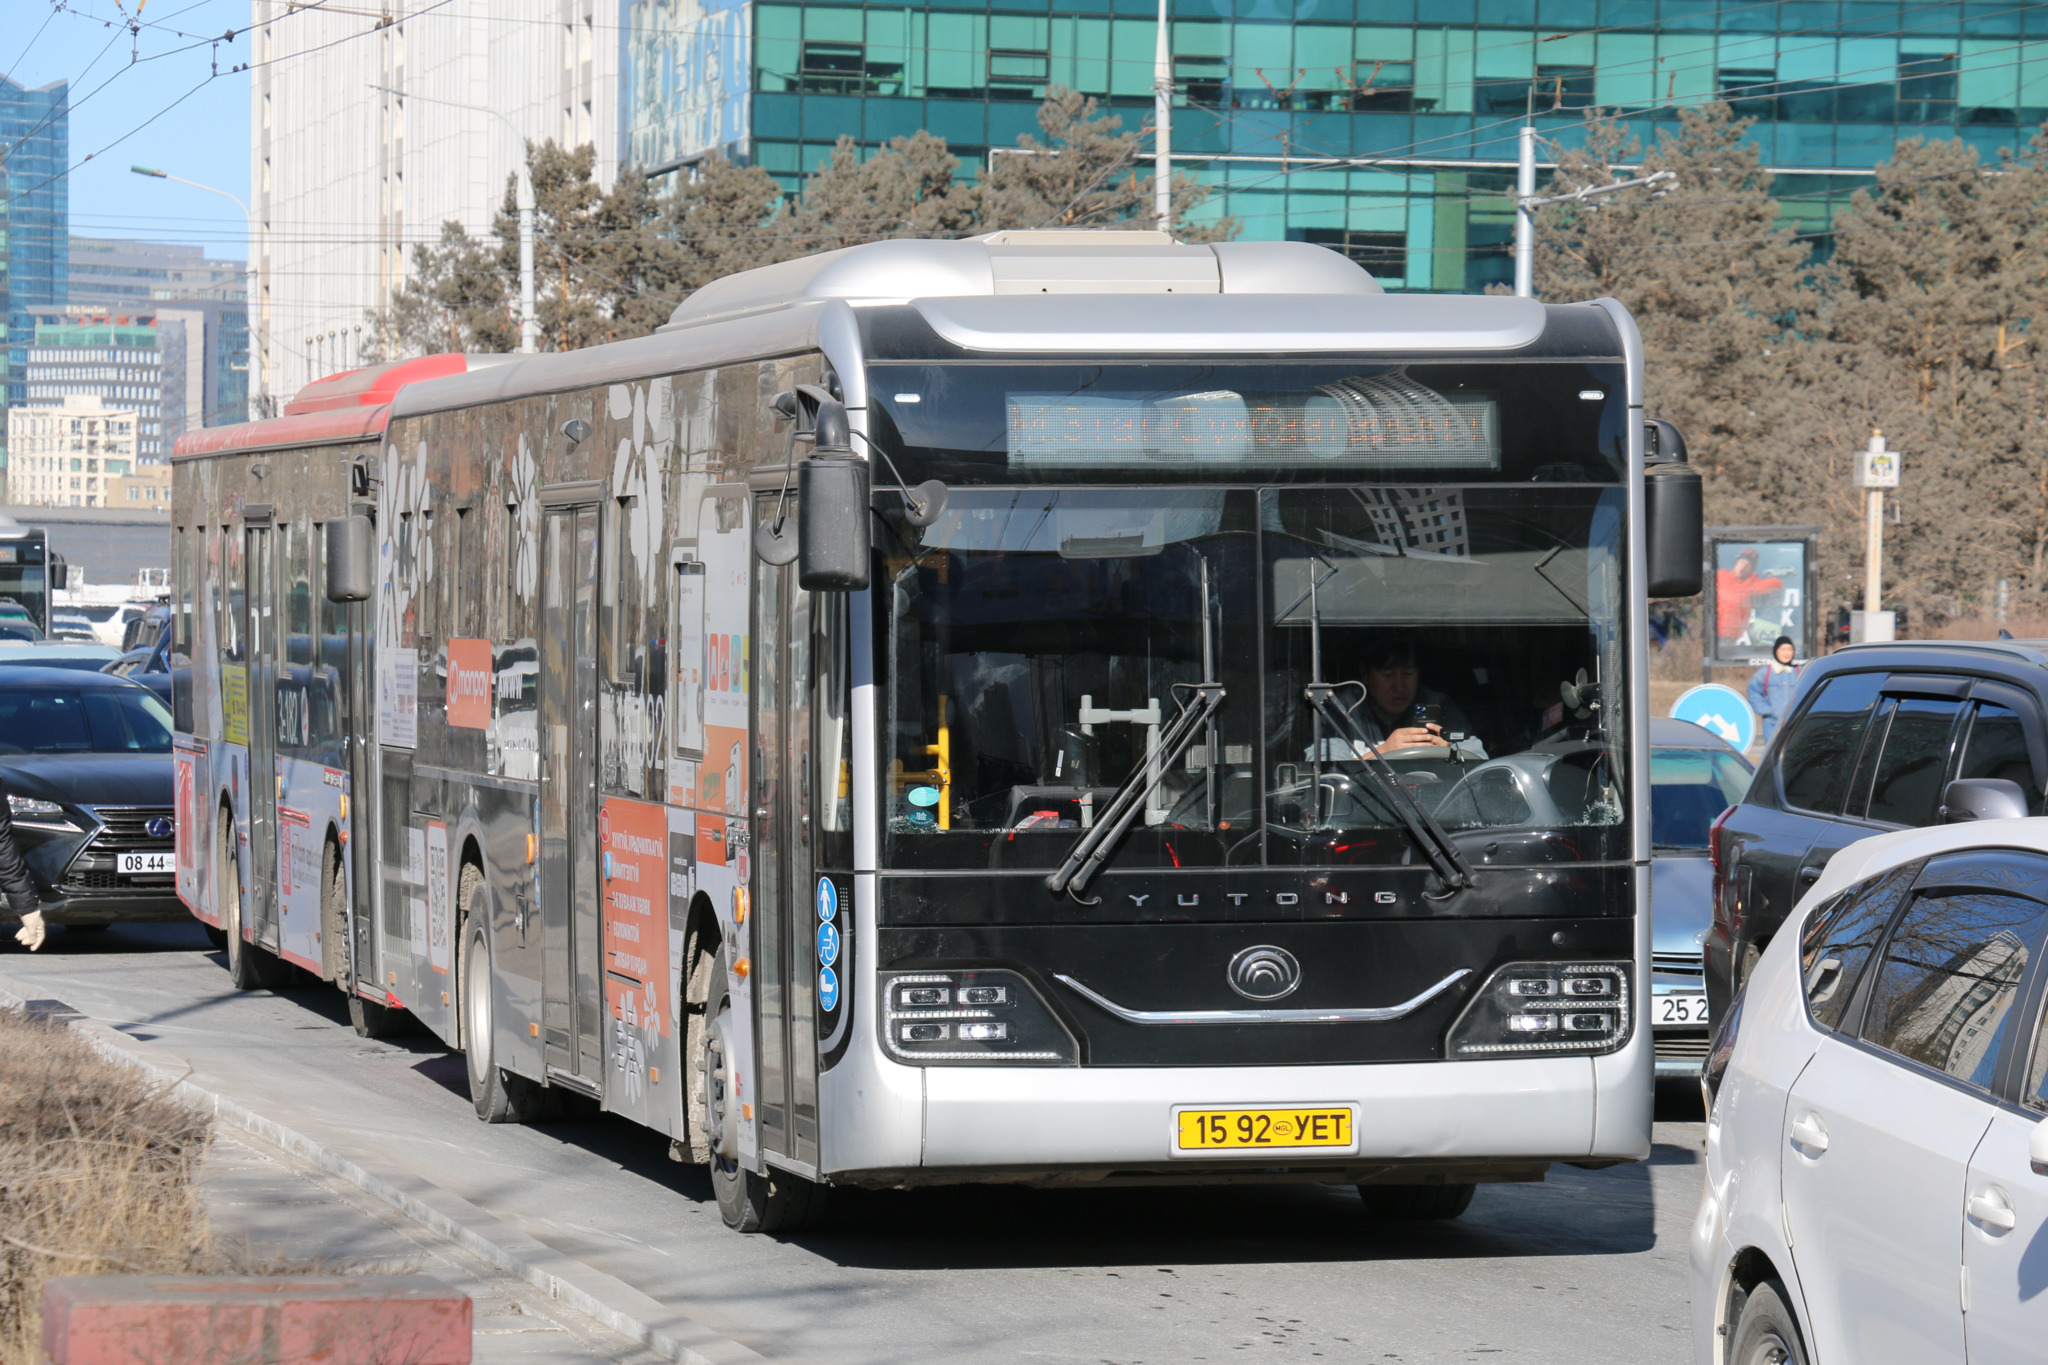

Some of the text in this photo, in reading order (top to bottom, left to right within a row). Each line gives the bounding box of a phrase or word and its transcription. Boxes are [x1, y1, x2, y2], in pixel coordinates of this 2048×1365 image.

[458, 669, 489, 705] monpay
[125, 855, 165, 871] 08 44
[1128, 891, 1398, 907] YUTONG
[1662, 998, 1690, 1021] 25
[1196, 1114, 1228, 1144] 15
[1237, 1114, 1271, 1143] 92
